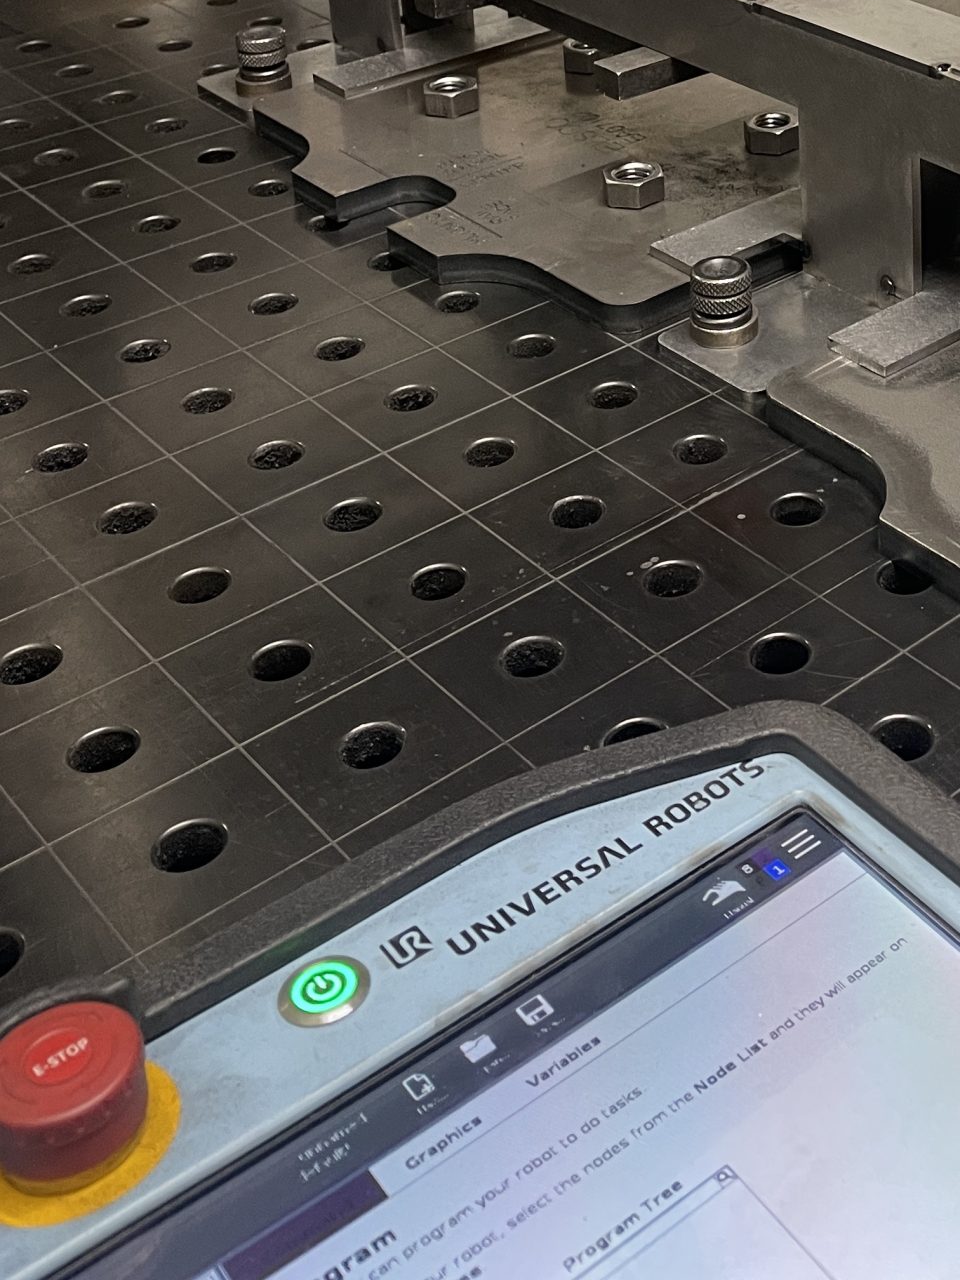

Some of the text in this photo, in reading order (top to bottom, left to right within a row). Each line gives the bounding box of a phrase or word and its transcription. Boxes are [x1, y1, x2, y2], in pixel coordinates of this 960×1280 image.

[446, 836, 643, 957] UNIVERSAL
[642, 757, 765, 837] ROBOTS
[32, 1036, 89, 1077] E-STOP
[404, 1115, 482, 1170] Graphics
[525, 1035, 602, 1088] Variables
[505, 1192, 552, 1230] select
[553, 1171, 582, 1196] the
[582, 1137, 630, 1175] nodes
[630, 1110, 669, 1140] from
[668, 1090, 694, 1114] the
[693, 1060, 737, 1094] Node
[737, 1037, 768, 1062] List
[769, 1017, 796, 1041] and
[794, 995, 826, 1022] they
[824, 979, 847, 999] will
[846, 949, 888, 985] appear
[889, 936, 909, 952] on
[402, 1204, 474, 1261] program
[475, 1176, 511, 1209] your
[515, 1145, 559, 1181] robot
[558, 1132, 578, 1150] to
[580, 1115, 601, 1135] do
[562, 1179, 684, 1273] Program Tree
